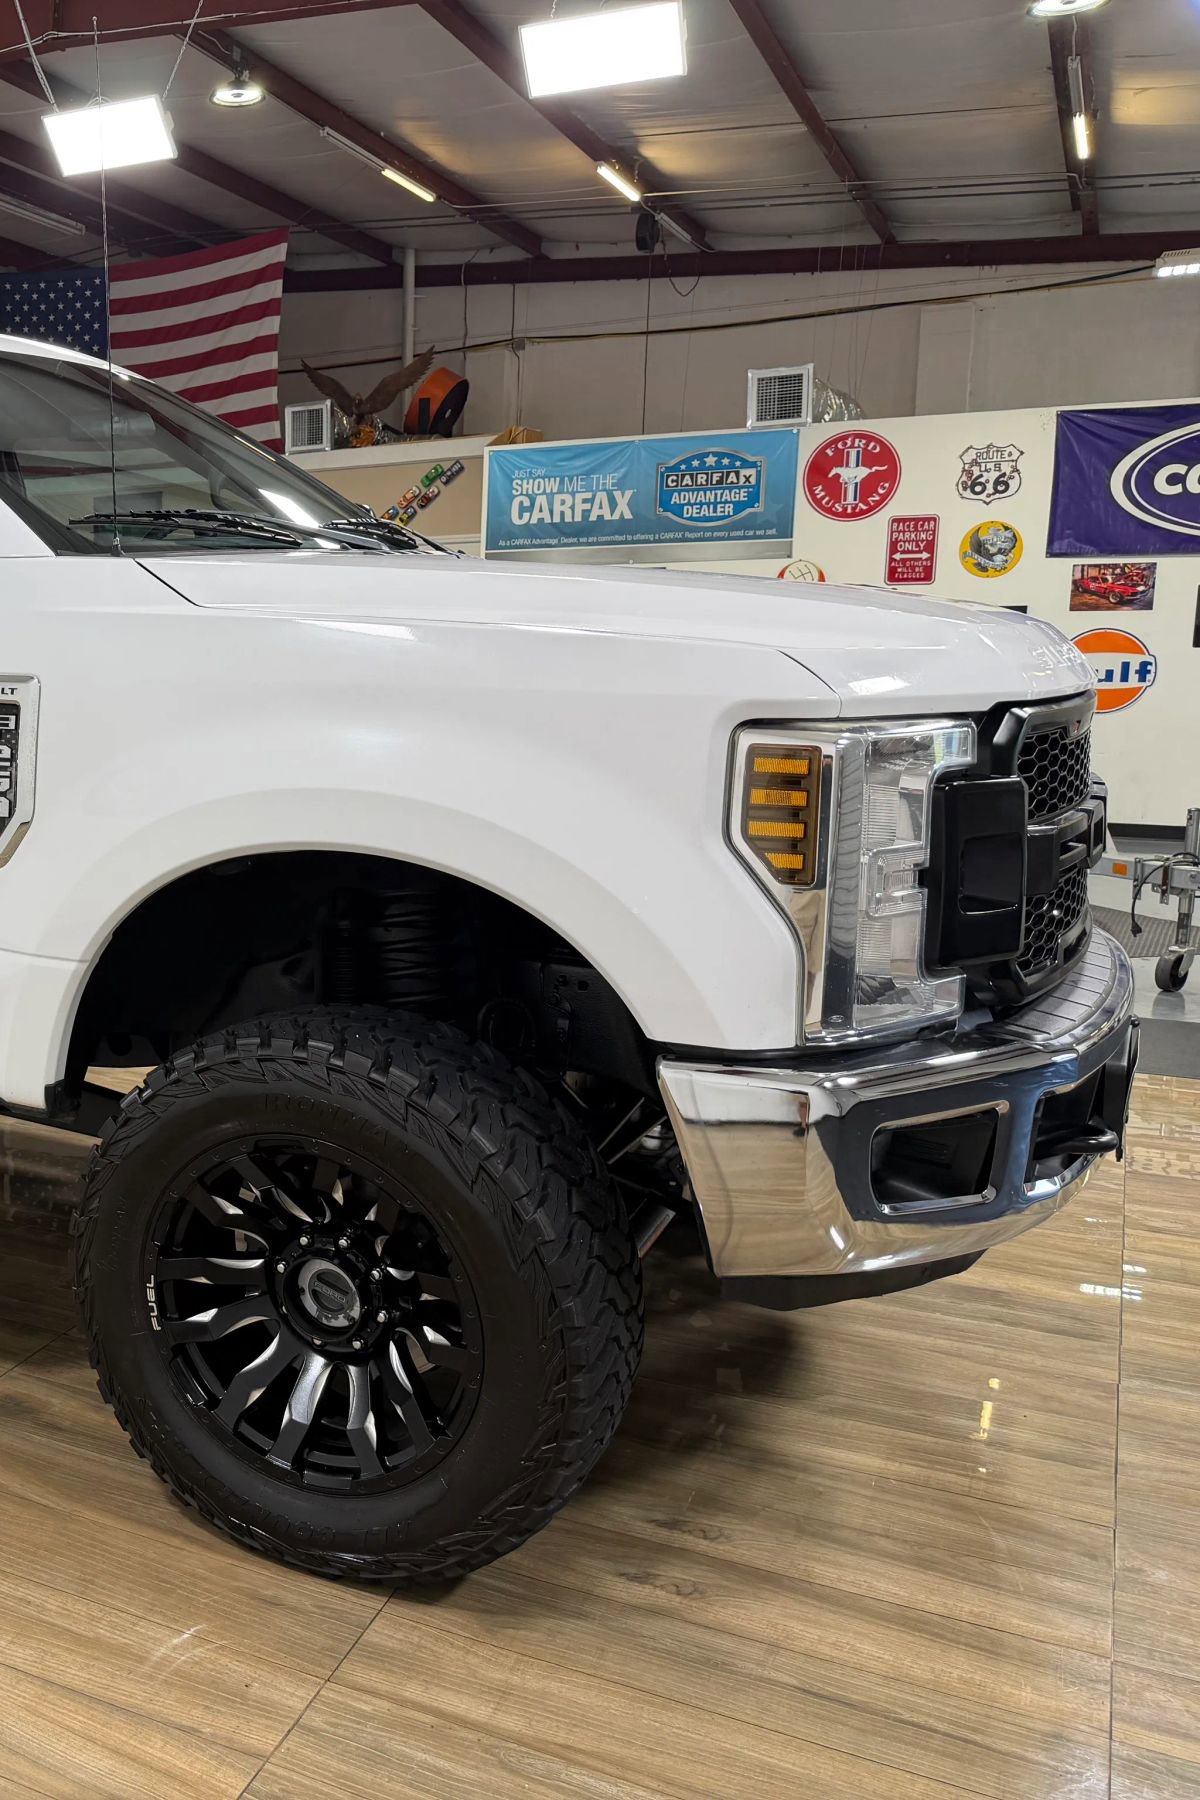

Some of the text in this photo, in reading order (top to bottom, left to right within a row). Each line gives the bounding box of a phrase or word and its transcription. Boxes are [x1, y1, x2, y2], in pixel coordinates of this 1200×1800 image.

[824, 435, 881, 457] FORD
[975, 449, 1007, 461] ROUTE
[511, 468, 546, 478] JUST SAY
[667, 470, 753, 488] CARFAX
[512, 473, 618, 495] SHOW ME THE
[969, 472, 1010, 496] 66
[812, 481, 891, 513] MUSTANG
[511, 490, 634, 526] CARFAX
[683, 503, 734, 518] DEALER
[892, 520, 935, 532] RACE CAR
[892, 531, 933, 542] PARKING
[897, 541, 927, 551] ONLY
[1095, 660, 1153, 683] ulf
[146, 1273, 162, 1331] FUEL
